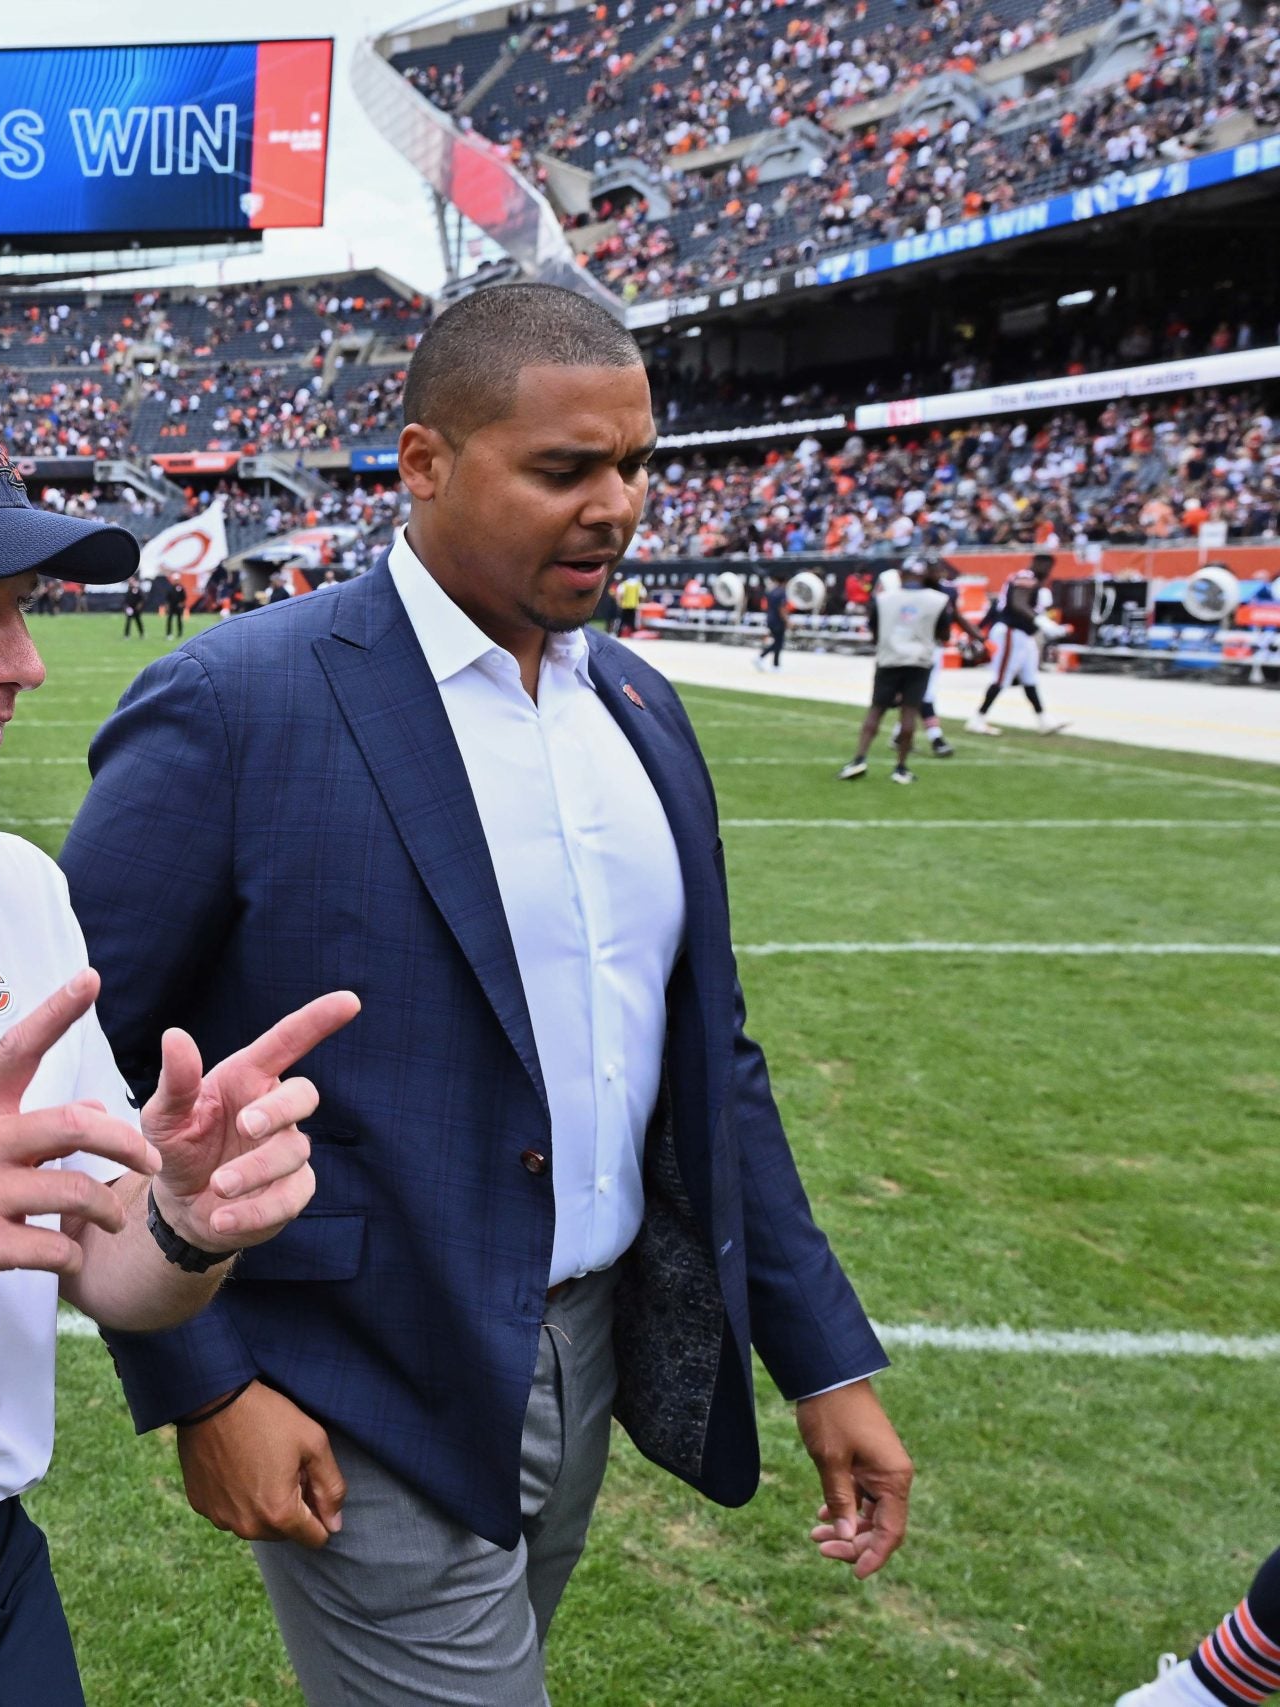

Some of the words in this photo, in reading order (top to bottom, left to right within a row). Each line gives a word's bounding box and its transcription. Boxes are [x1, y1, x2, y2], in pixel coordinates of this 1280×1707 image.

[69, 104, 237, 177] WIN
[891, 217, 987, 267] BEARS
[987, 200, 1050, 240] WIN
